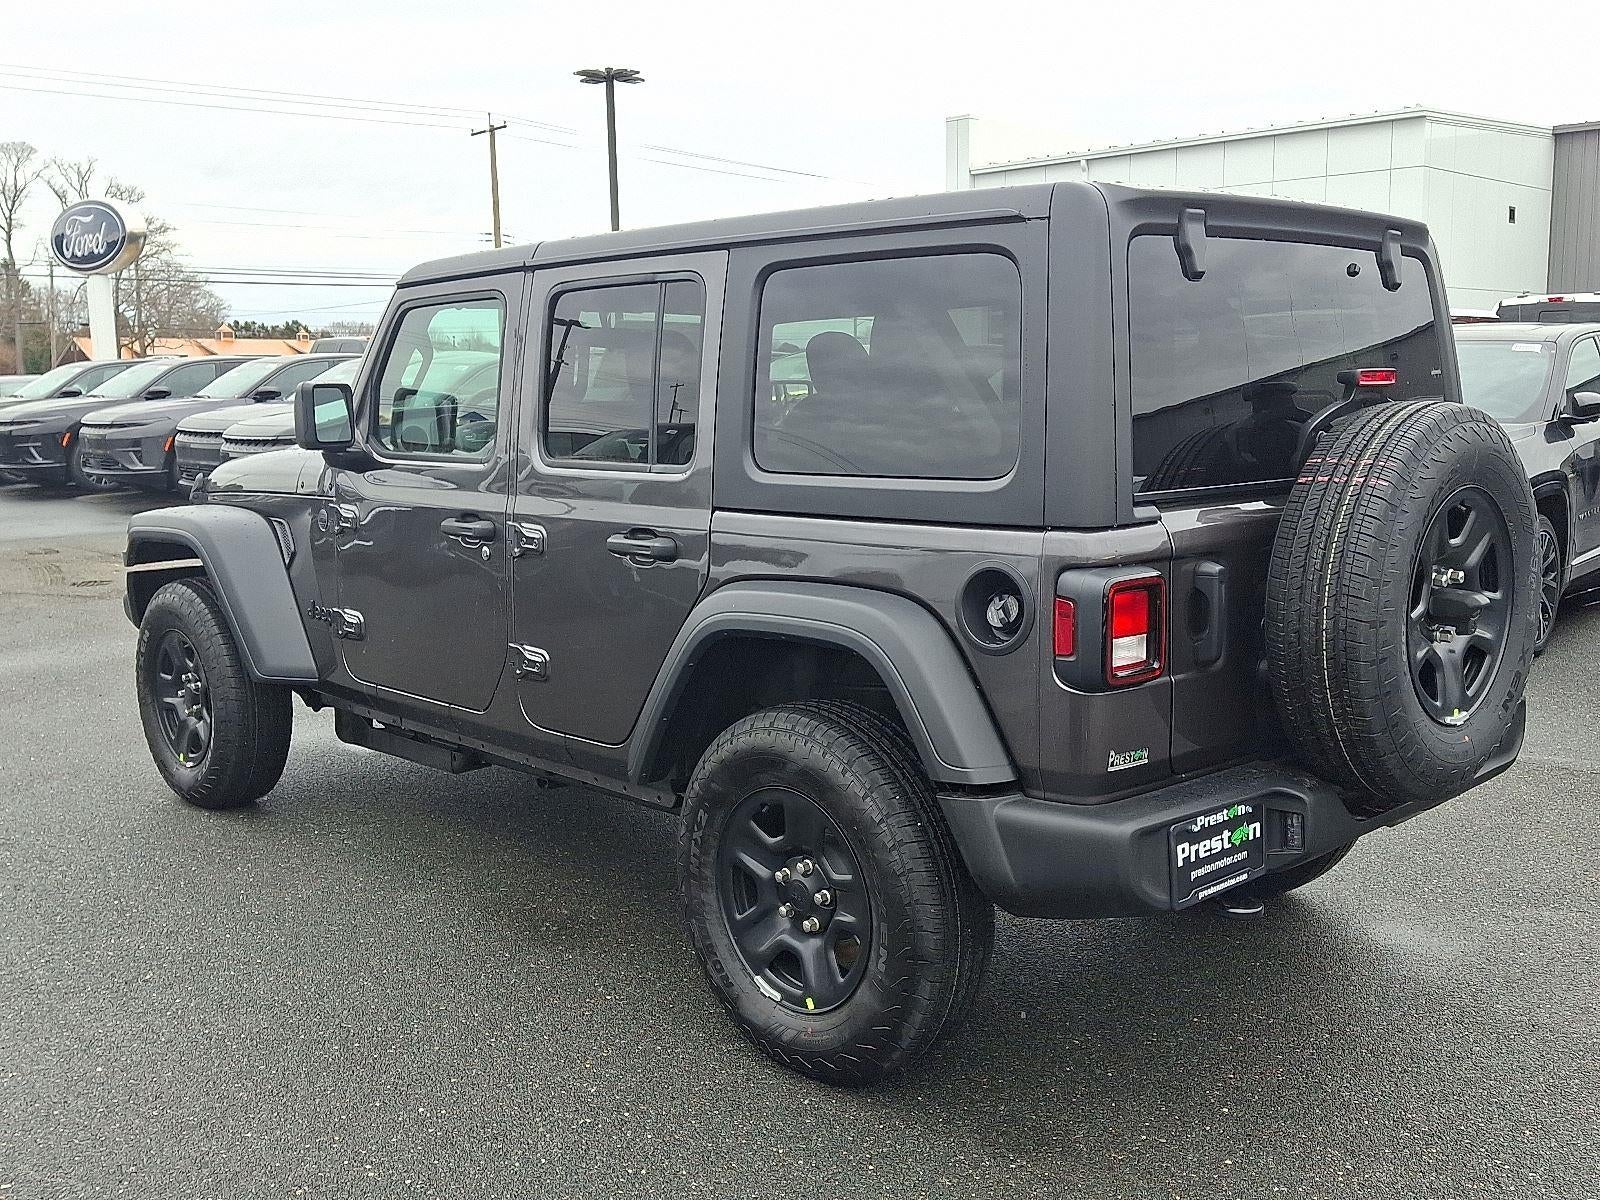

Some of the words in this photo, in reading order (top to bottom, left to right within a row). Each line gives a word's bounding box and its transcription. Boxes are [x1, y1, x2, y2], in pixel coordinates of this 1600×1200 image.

[62, 214, 107, 259] Ford
[1196, 803, 1246, 829] Preston
[1176, 820, 1261, 868] Preston
[1190, 850, 1248, 882] prestonmotor.com
